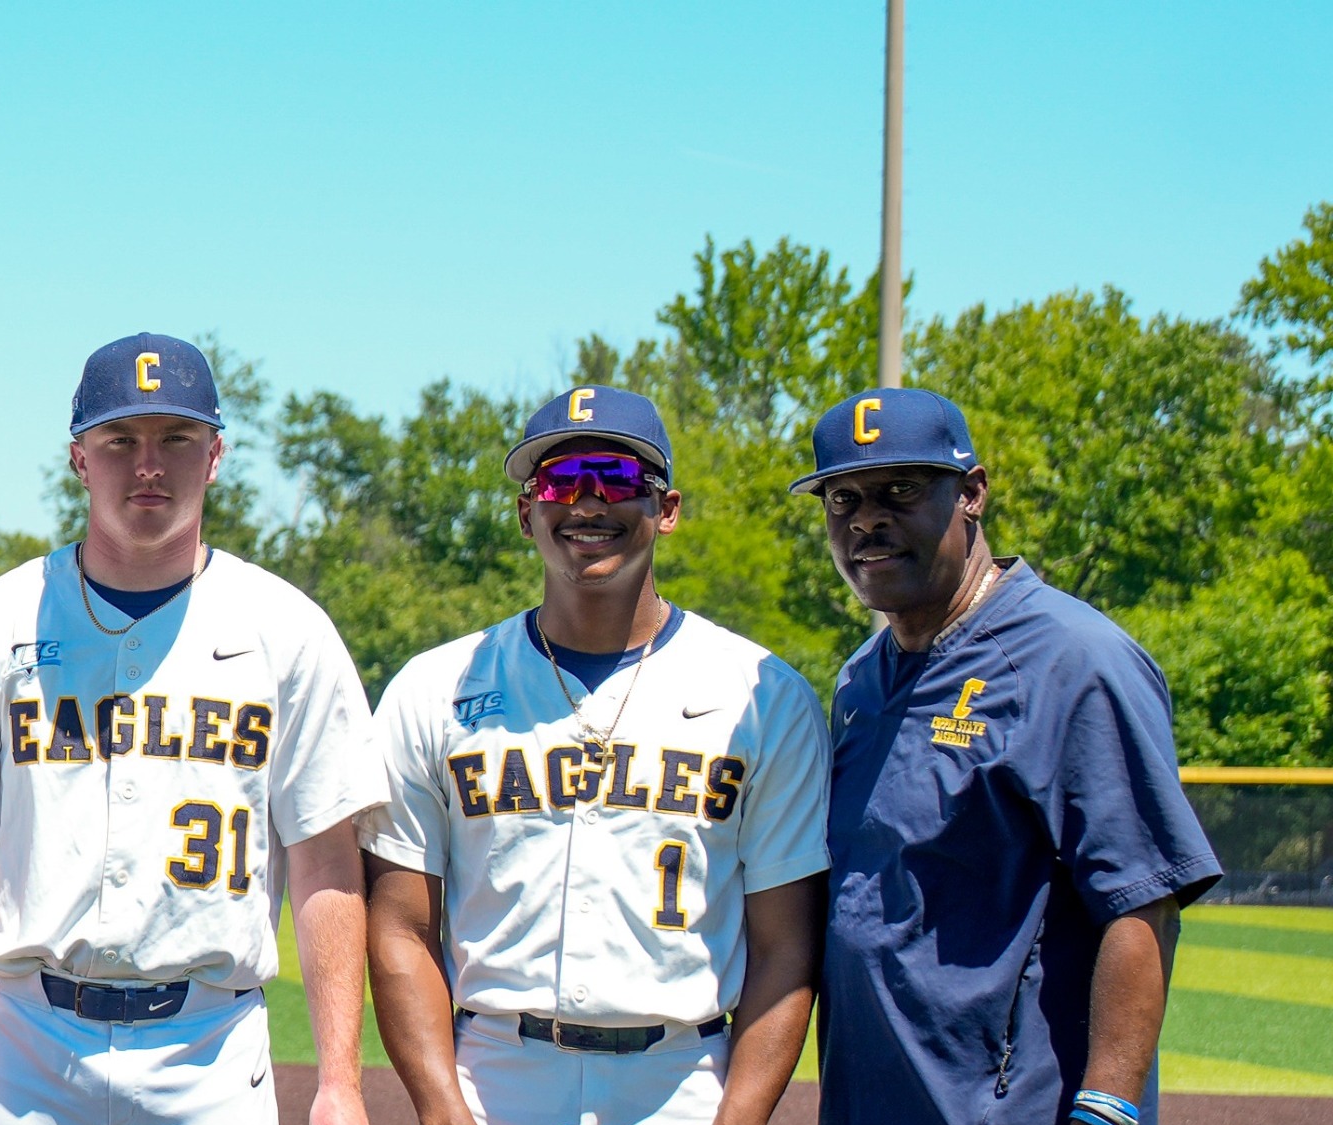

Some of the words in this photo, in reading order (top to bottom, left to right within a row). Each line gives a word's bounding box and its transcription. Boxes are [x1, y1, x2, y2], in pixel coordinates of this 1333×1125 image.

[136, 352, 161, 392] C
[568, 388, 595, 422] C
[854, 397, 881, 445] C
[953, 677, 987, 719] C
[8, 692, 274, 770] EAGLES
[447, 739, 747, 823] EAGLES
[165, 799, 252, 895] 31
[652, 840, 687, 931] 1
